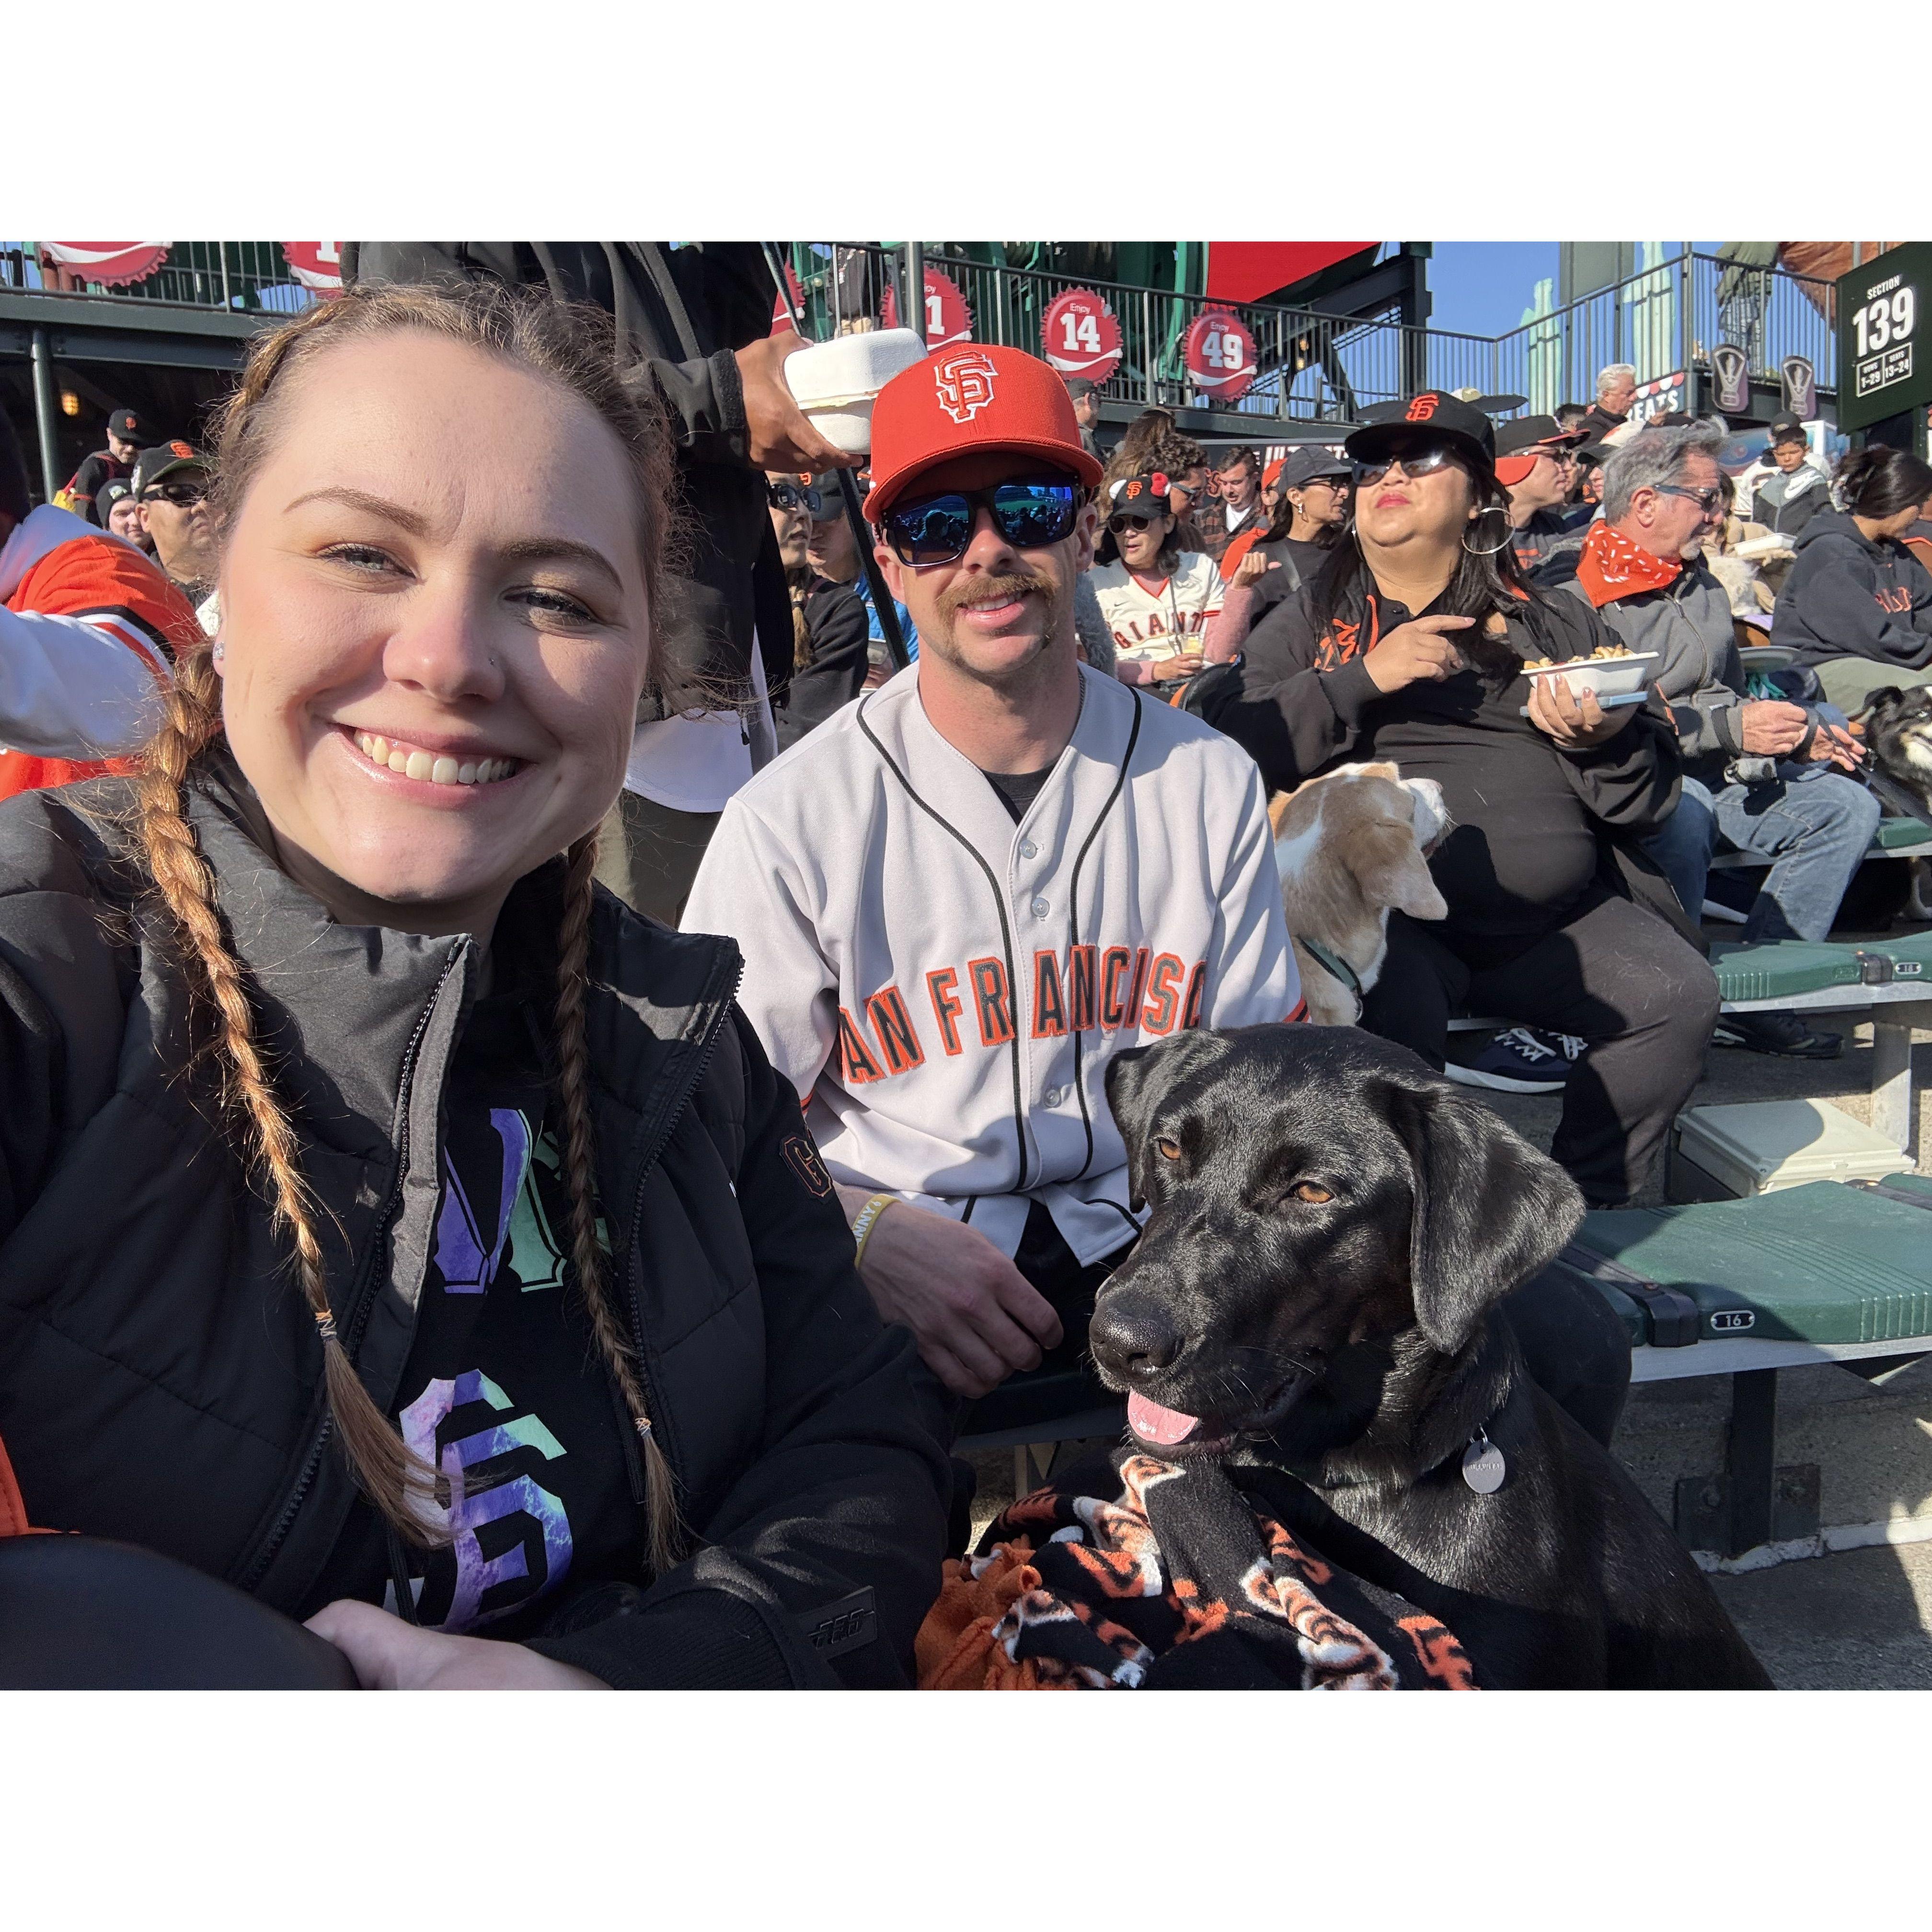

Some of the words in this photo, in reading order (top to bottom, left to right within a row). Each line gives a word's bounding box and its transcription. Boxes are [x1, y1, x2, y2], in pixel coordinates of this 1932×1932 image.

[1866, 274, 1902, 300] SECTION
[1070, 303, 1091, 314] Enjoy
[1060, 312, 1101, 353] 14
[1210, 322, 1230, 333] Enjoy
[1852, 287, 1914, 357] 139
[1202, 332, 1243, 369] 49
[1885, 358, 1909, 379] 13-24
[934, 351, 999, 424] SF
[1405, 393, 1439, 422] SF
[1127, 481, 1143, 500] SF
[1725, 1314, 1742, 1327] 16
